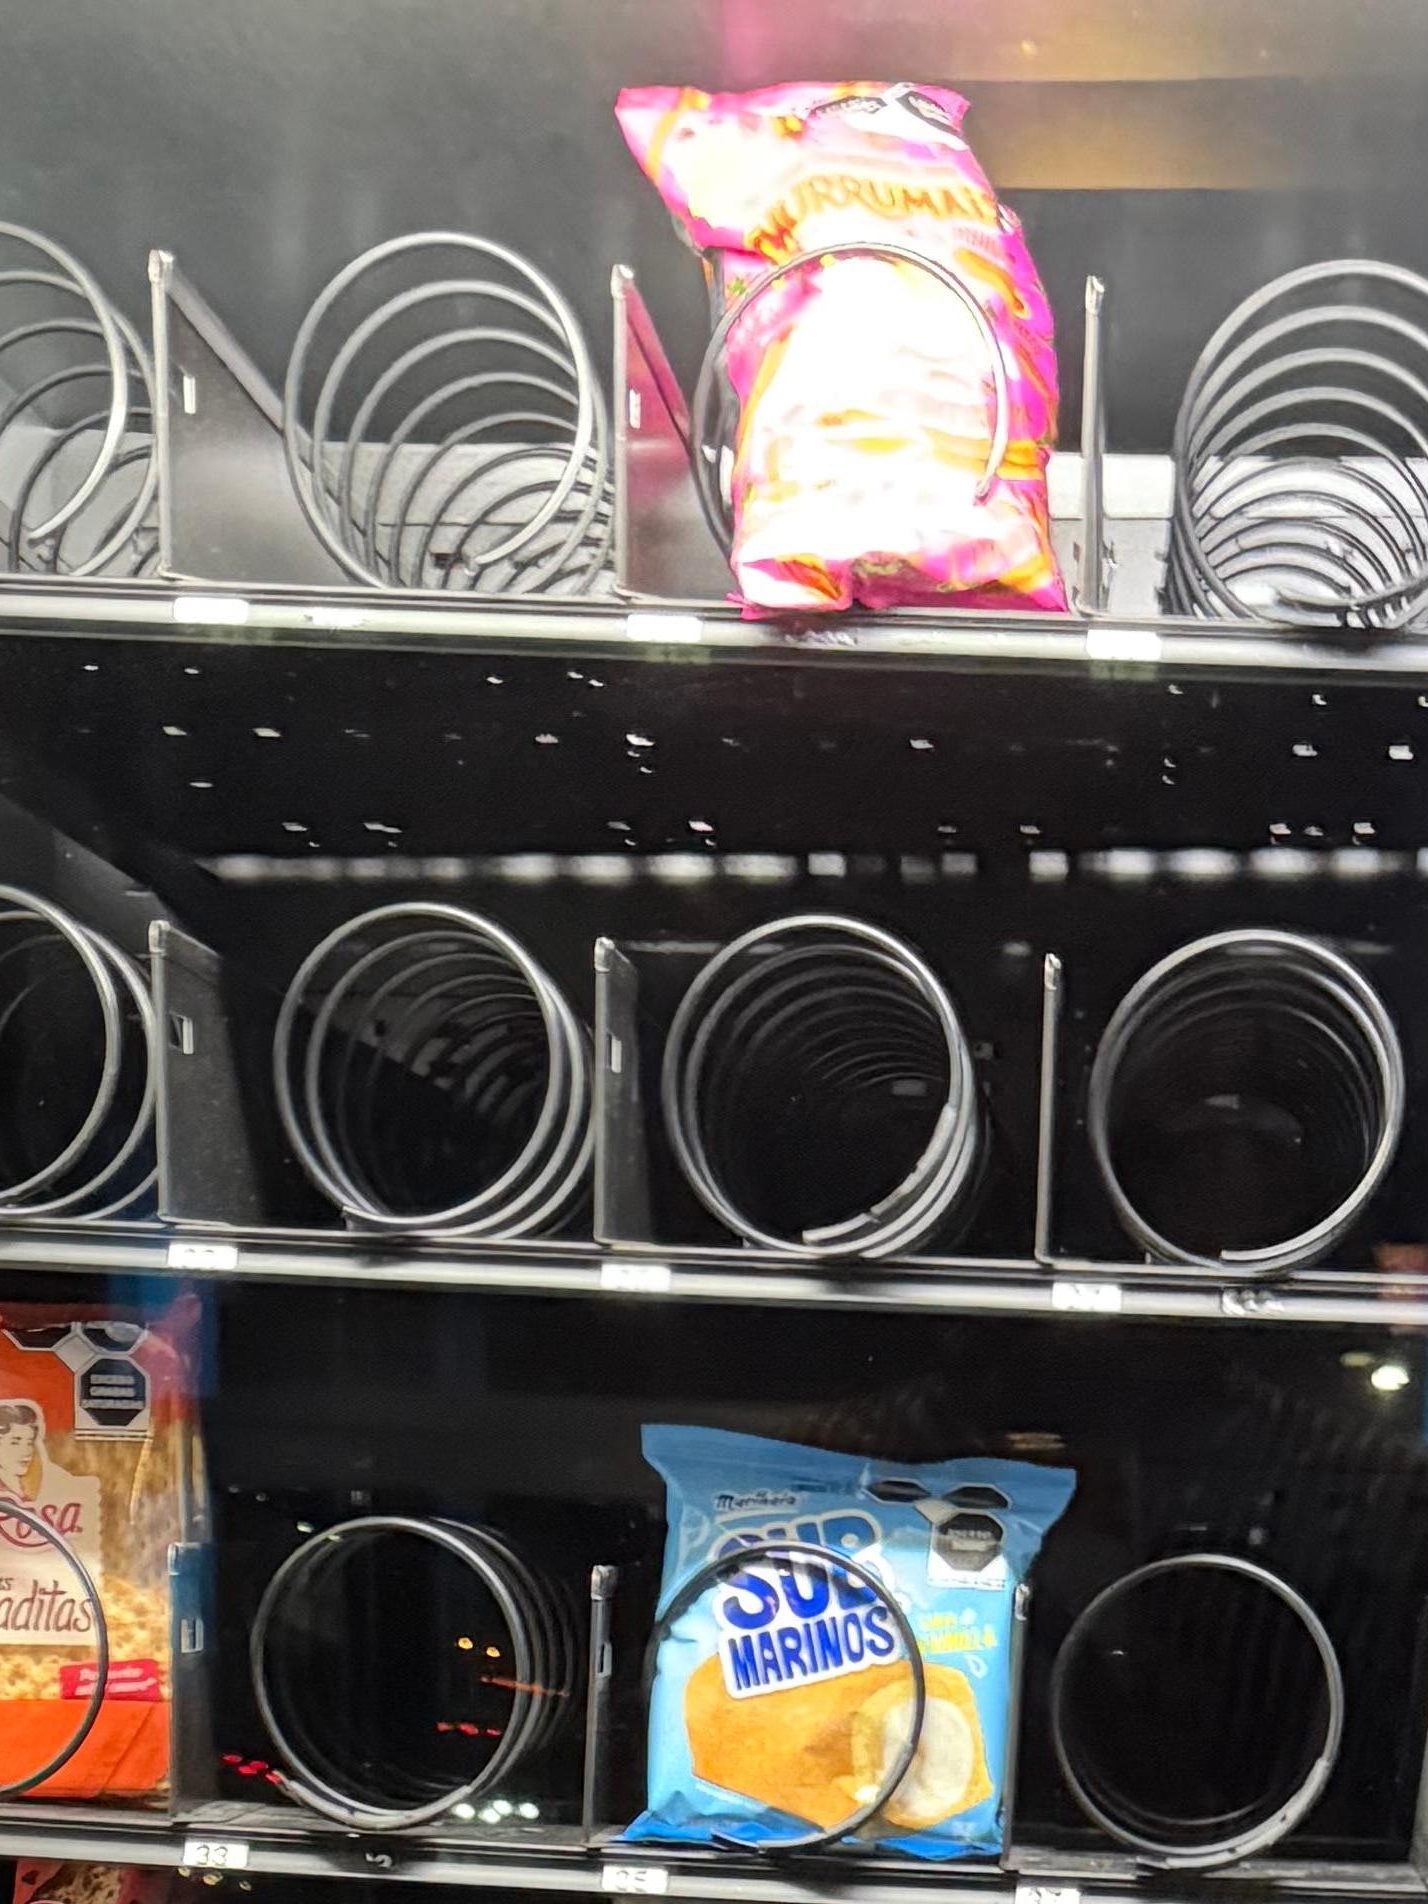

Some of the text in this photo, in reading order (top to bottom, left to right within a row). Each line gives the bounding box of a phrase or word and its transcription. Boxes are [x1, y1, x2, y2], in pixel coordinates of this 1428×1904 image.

[715, 1515, 881, 1630] SUB
[727, 1607, 894, 1691] MARINOS
[196, 1844, 229, 1866] 33
